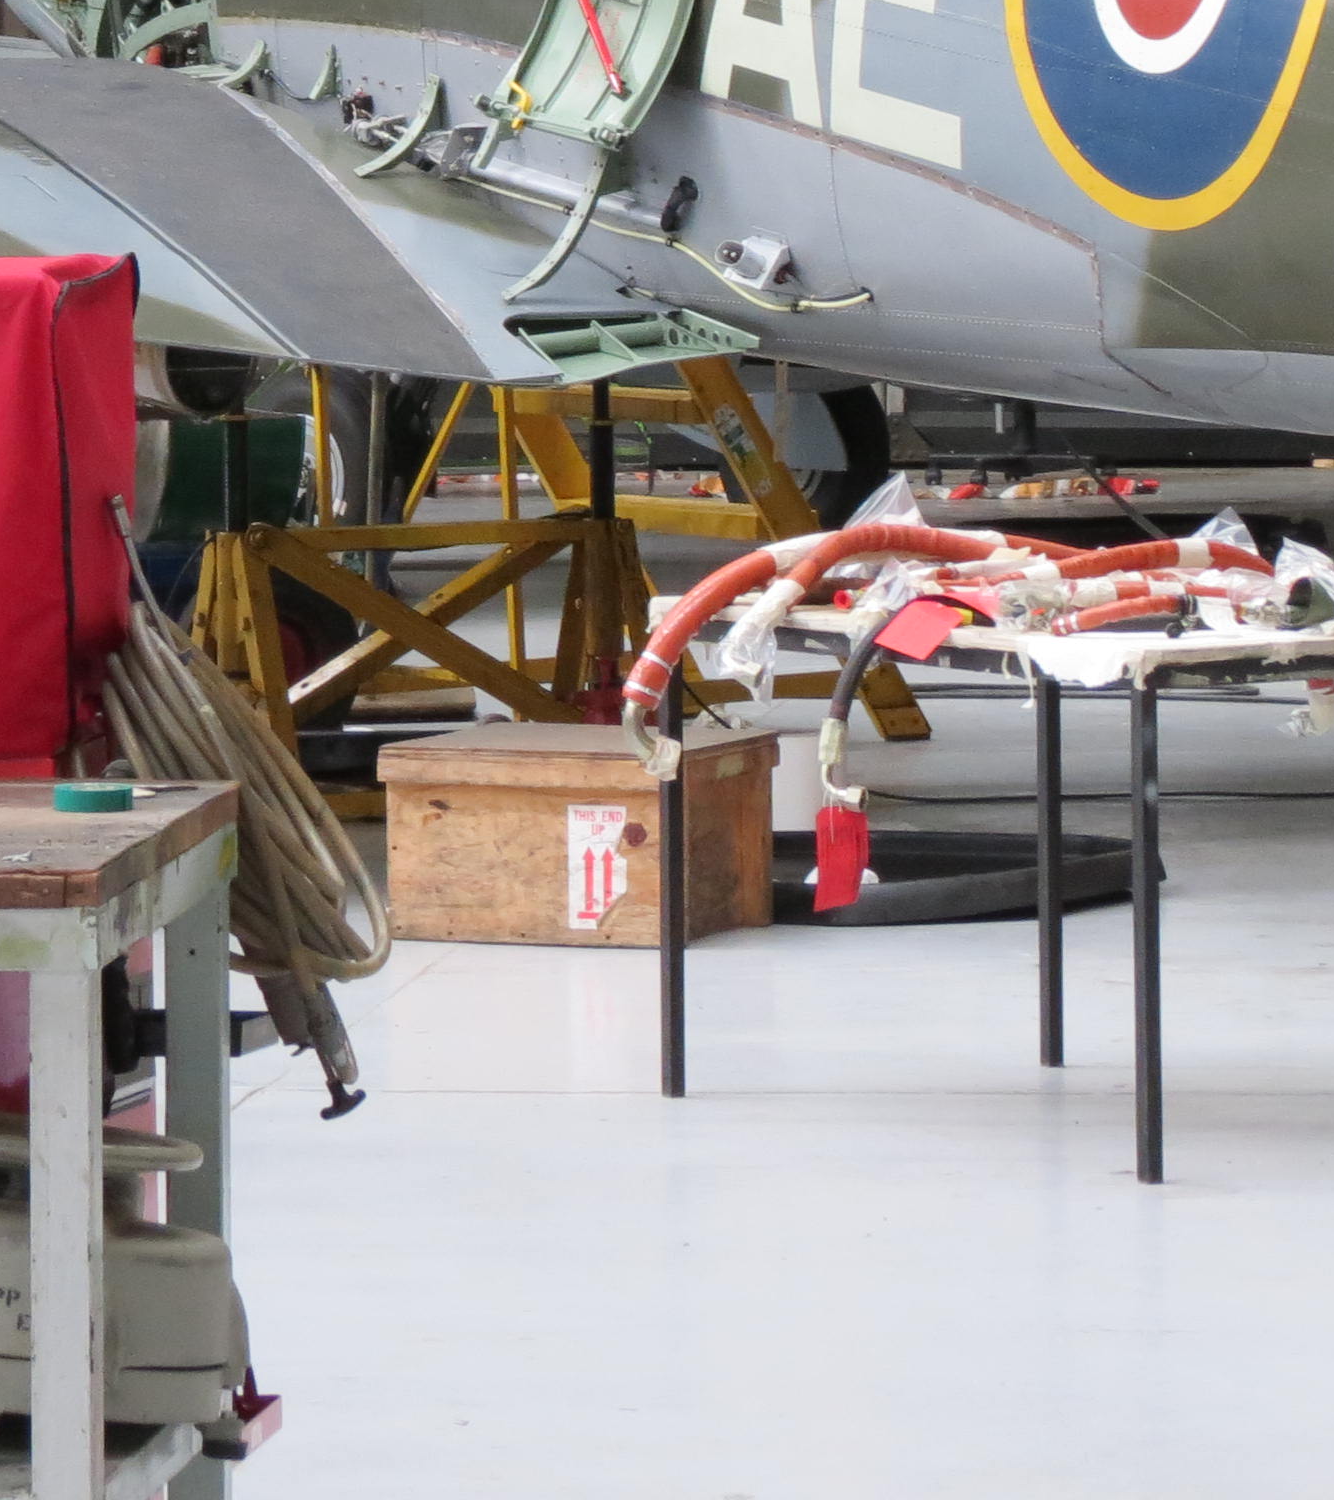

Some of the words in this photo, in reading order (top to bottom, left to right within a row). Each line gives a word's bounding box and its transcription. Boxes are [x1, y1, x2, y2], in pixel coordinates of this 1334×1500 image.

[573, 810, 597, 823] THIS
[601, 810, 624, 823] END
[591, 823, 606, 836] UP
